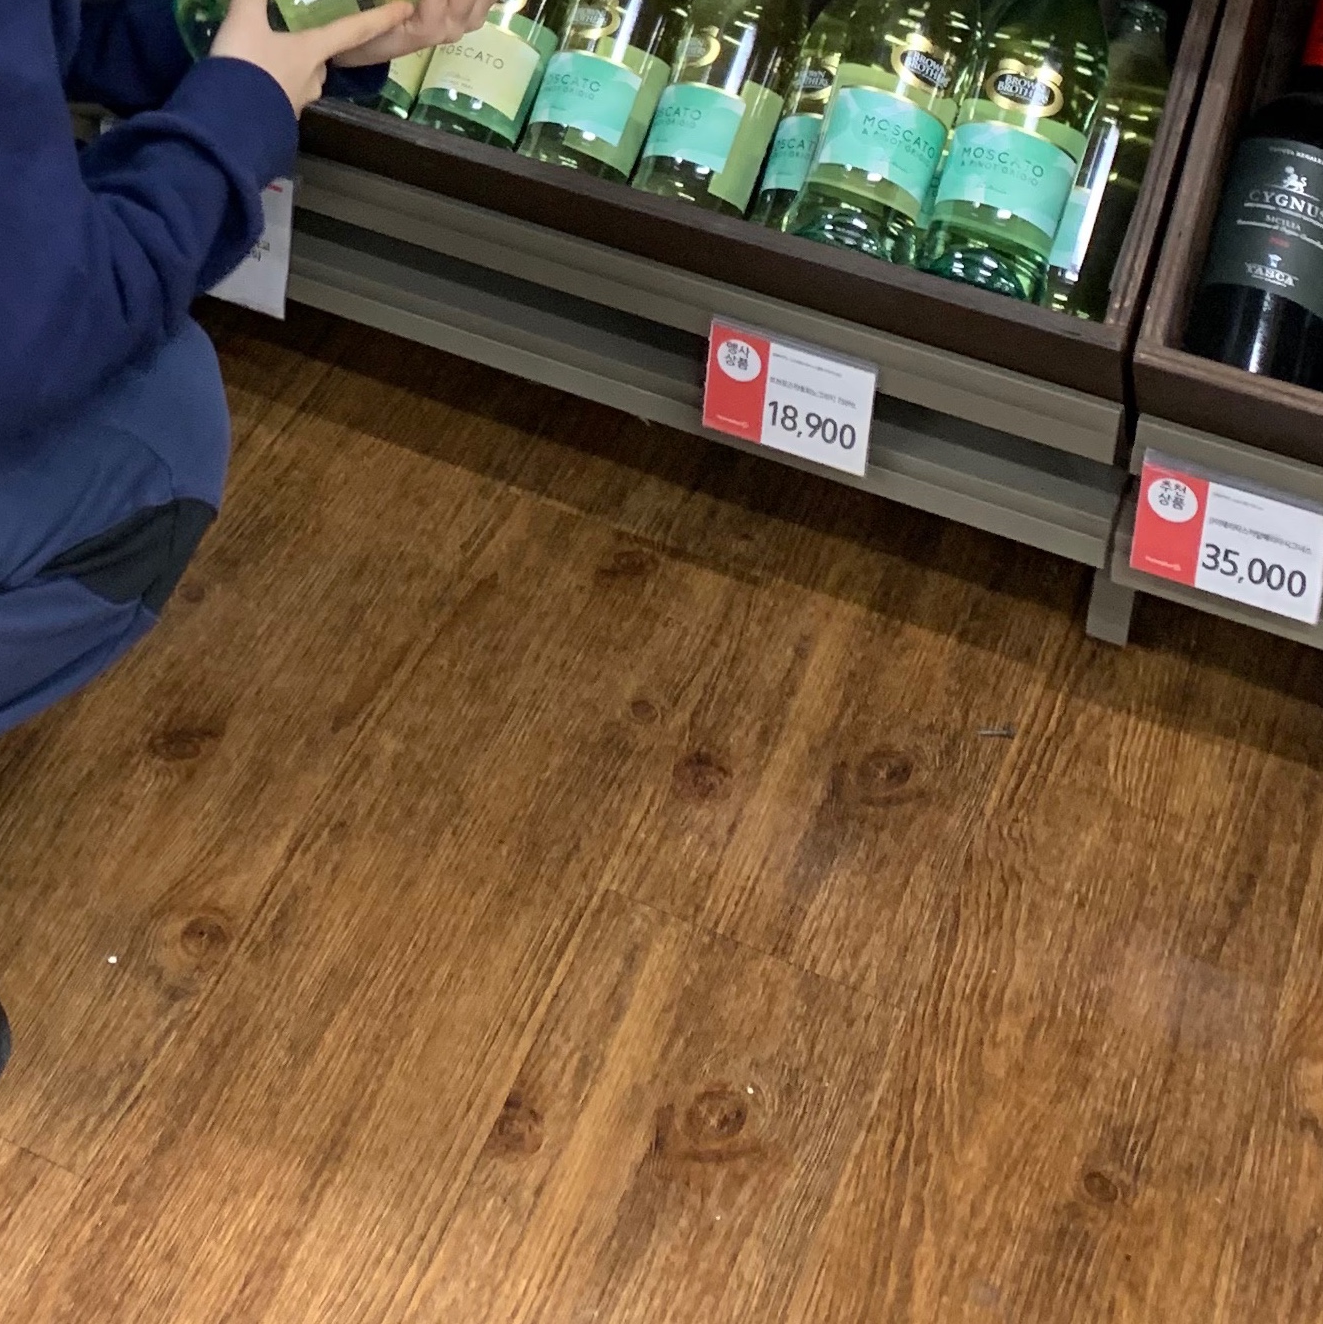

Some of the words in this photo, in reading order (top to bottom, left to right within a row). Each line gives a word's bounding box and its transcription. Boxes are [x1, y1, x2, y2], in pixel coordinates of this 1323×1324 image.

[863, 114, 936, 159] MOSCATO
[961, 146, 1045, 178] MOSCATO
[1265, 214, 1302, 232] SICILIA
[726, 341, 750, 358] 행사
[724, 354, 749, 371] 상품
[768, 400, 856, 450] 18,900
[1159, 479, 1187, 499] 추천
[1157, 492, 1185, 511] 상품
[1201, 542, 1307, 598] 35,000
